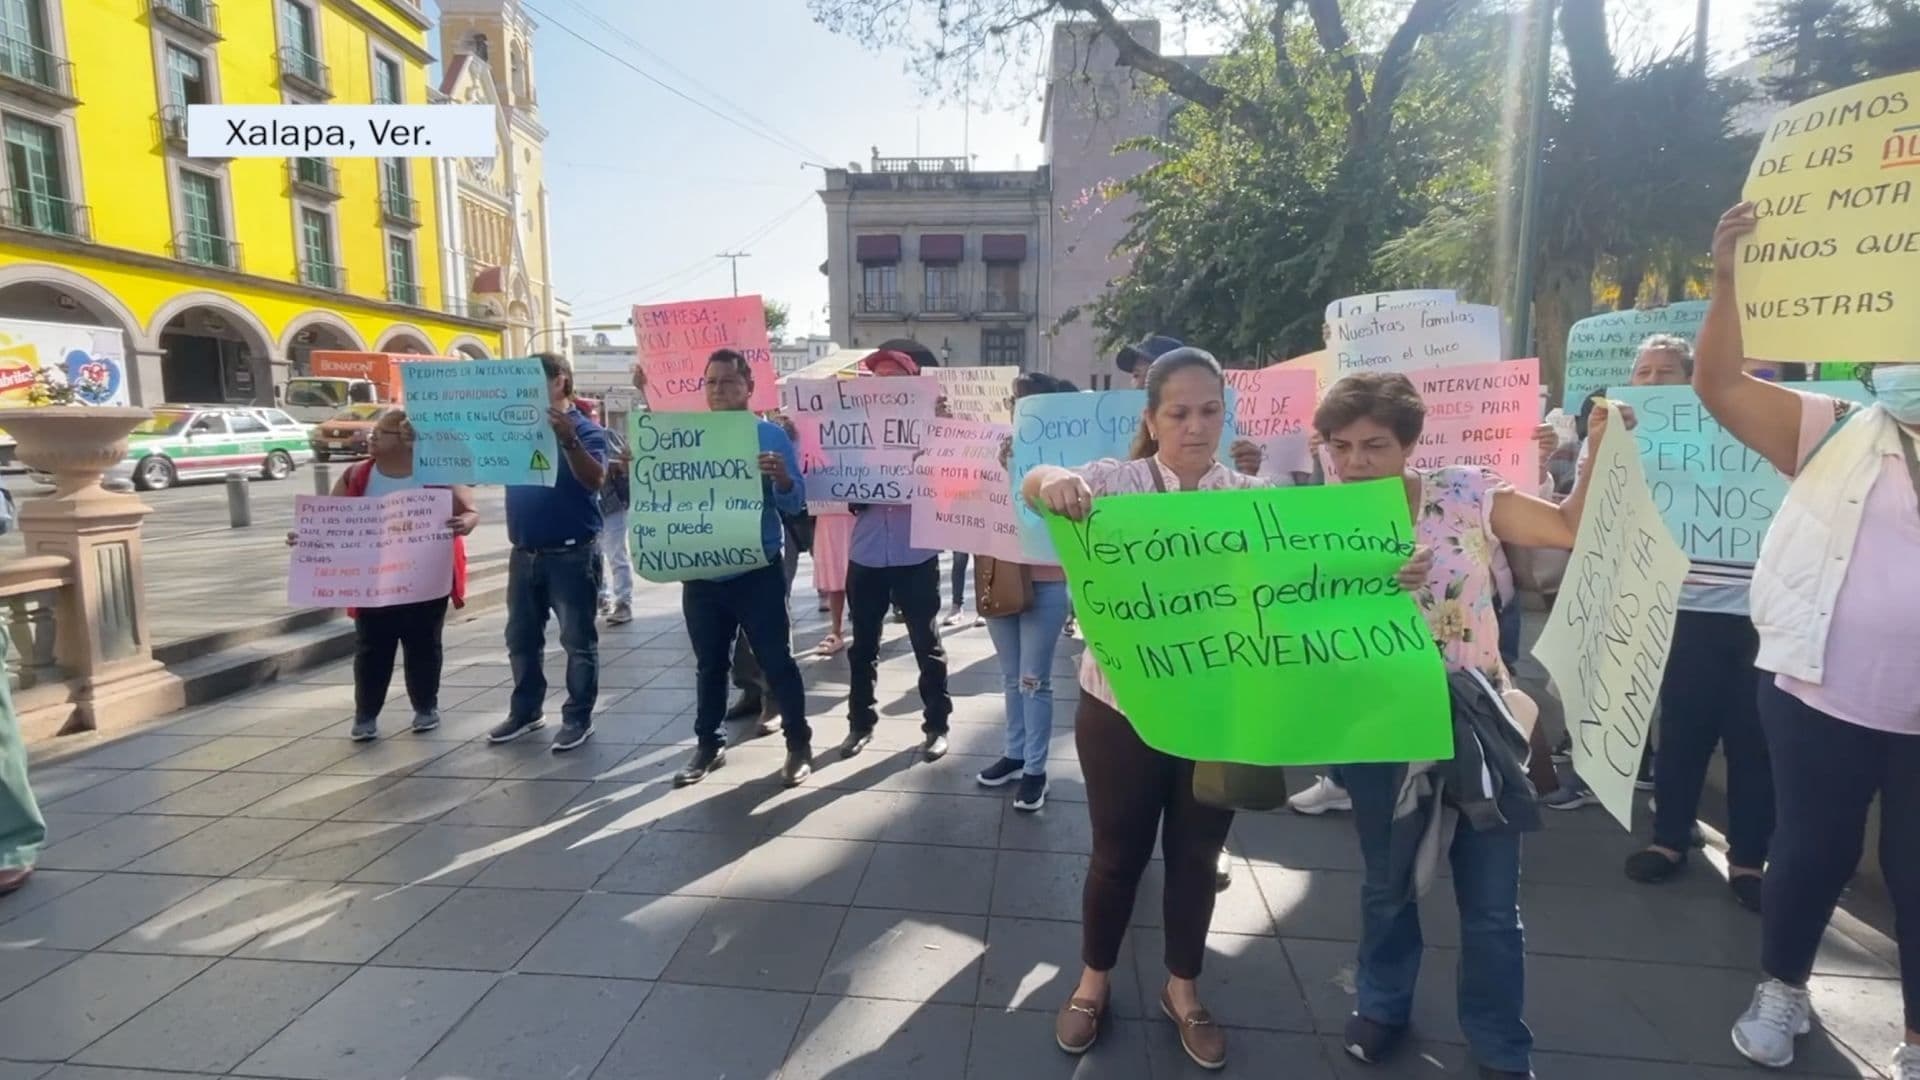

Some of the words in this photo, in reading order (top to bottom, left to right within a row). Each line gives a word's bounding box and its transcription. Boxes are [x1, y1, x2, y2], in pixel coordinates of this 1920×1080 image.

[1771, 92, 1909, 142] PEDIMOS
[1758, 154, 1792, 177] DE
[1805, 144, 1853, 169] LAS
[1753, 193, 1812, 220] QUE
[1827, 180, 1911, 210] MOTA
[1743, 237, 1837, 263] DAÑOS
[1856, 231, 1920, 254] QUE
[1745, 291, 1894, 320] NUESTRAS
[1339, 318, 1405, 341] Nuestras
[320, 359, 374, 371] BONAFONT
[408, 366, 458, 379] PEDIMOS
[1423, 366, 1530, 393] INTERVENCIÓN
[795, 386, 823, 412] La
[837, 381, 915, 418] Empresa:
[1271, 396, 1290, 416] DE
[1481, 399, 1520, 415] PARA
[434, 411, 461, 422] MOTA
[1019, 403, 1090, 444] Señor
[639, 415, 705, 452] Señor
[819, 420, 873, 446] MOTA
[927, 424, 977, 440] PEDIMOS
[1462, 427, 1513, 442] PAGUE
[635, 456, 752, 492] GOBERNADOR
[940, 467, 969, 480] MOTA
[1415, 456, 1446, 470] QUE
[635, 488, 672, 513] usted
[677, 501, 693, 512] es
[698, 488, 714, 512] el
[725, 496, 764, 511] único
[989, 492, 1009, 506] QUE
[1695, 484, 1773, 520] NOS
[633, 524, 656, 549] que
[668, 514, 713, 545] puede
[936, 511, 986, 529] NUESTRAS
[1072, 510, 1249, 565] Verónica
[1567, 452, 1628, 651] SERVICIOS
[1252, 563, 1401, 639] pedimos
[1604, 586, 1640, 667] NOS
[1630, 527, 1657, 581] HA
[1137, 617, 1425, 679] INTERVENCION
[1604, 580, 1673, 777] CUMPLIDO
